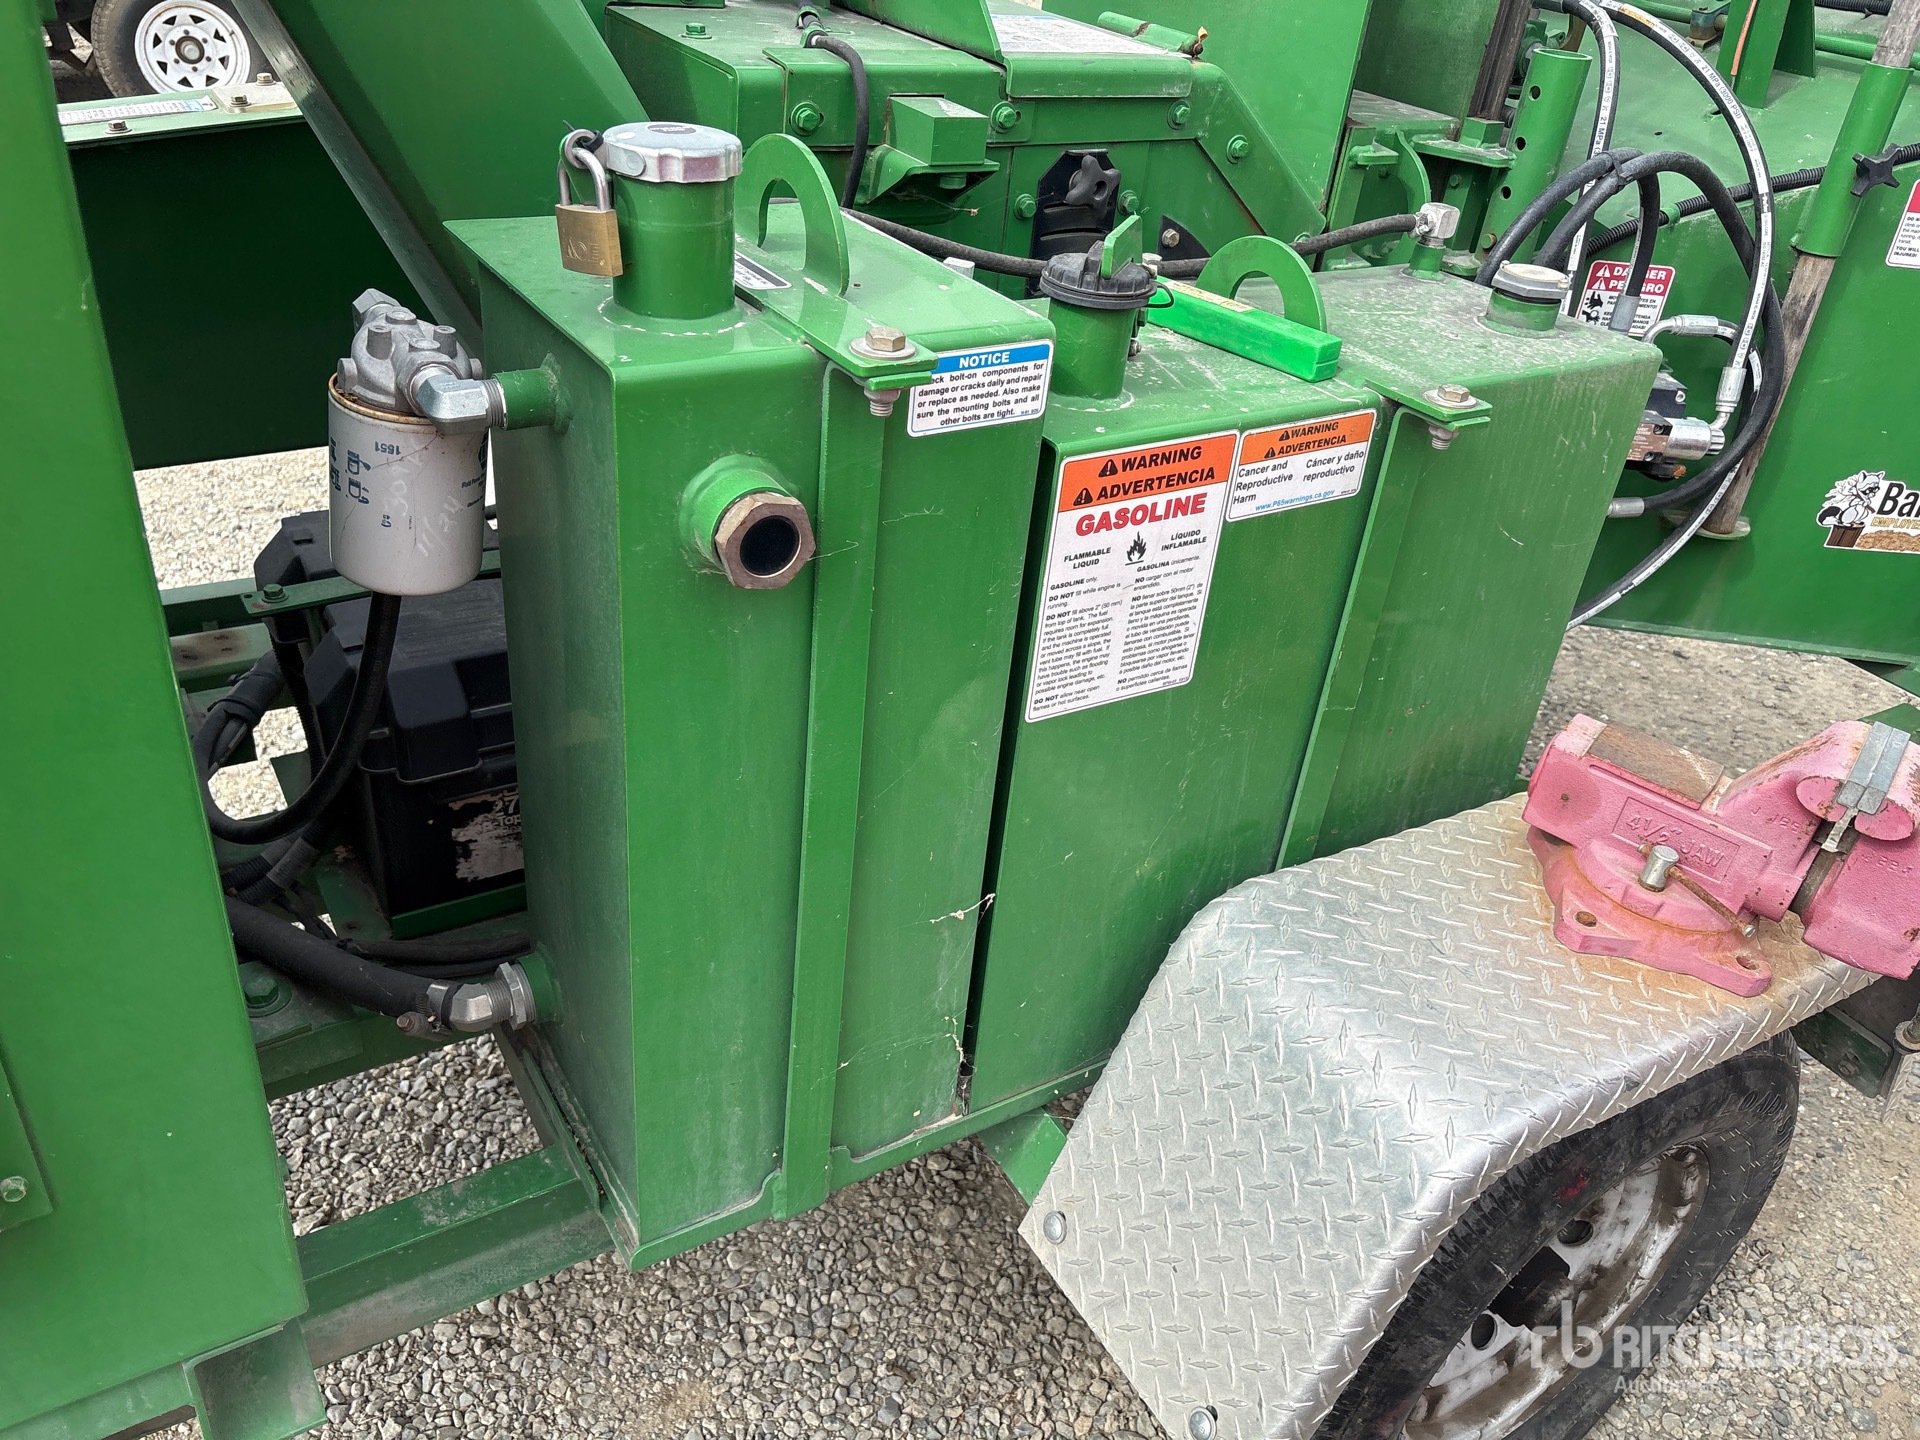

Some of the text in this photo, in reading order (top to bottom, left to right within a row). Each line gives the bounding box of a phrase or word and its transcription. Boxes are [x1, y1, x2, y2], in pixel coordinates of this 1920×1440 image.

[959, 352, 1010, 369] NOTICE
[950, 372, 977, 382] bolt-on
[982, 366, 1029, 378] components
[1034, 363, 1044, 371] for
[919, 387, 949, 397] damage
[961, 382, 986, 391] cracks
[987, 379, 1005, 388] daily
[1006, 377, 1020, 385] and
[1021, 373, 1043, 384] repair
[928, 396, 957, 408] replace
[971, 390, 1001, 401] needed.
[1002, 388, 1019, 396] Also
[1022, 385, 1041, 393] make
[917, 394, 1040, 419] sure the mounting bolts and all
[940, 417, 960, 426] other
[962, 414, 981, 423] bolts
[983, 412, 995, 420] are
[997, 410, 1015, 419] tight.
[1291, 422, 1339, 439] WARNING
[1278, 435, 1347, 456] ADVERTENCIA
[1121, 446, 1202, 472] WARNING
[1306, 450, 1364, 469] Cáncer y daño
[1239, 460, 1288, 478] Cancer and
[1303, 464, 1355, 482] reproductivo
[1096, 467, 1215, 501] ADVERTENCIA
[1236, 473, 1293, 491] Reproductive
[1233, 494, 1257, 505] Harm
[1076, 492, 1207, 537] GASOLINE
[1171, 529, 1201, 541] LÍQUIDO
[1161, 536, 1207, 552] INFLAMABLE
[1064, 547, 1111, 563] FLAMMABLE
[1073, 558, 1100, 570] LIQUID
[1137, 561, 1170, 572] GASOLINA
[1050, 579, 1084, 591] GASOLINE
[1060, 592, 1074, 600] NOT
[1057, 611, 1071, 619] NOT
